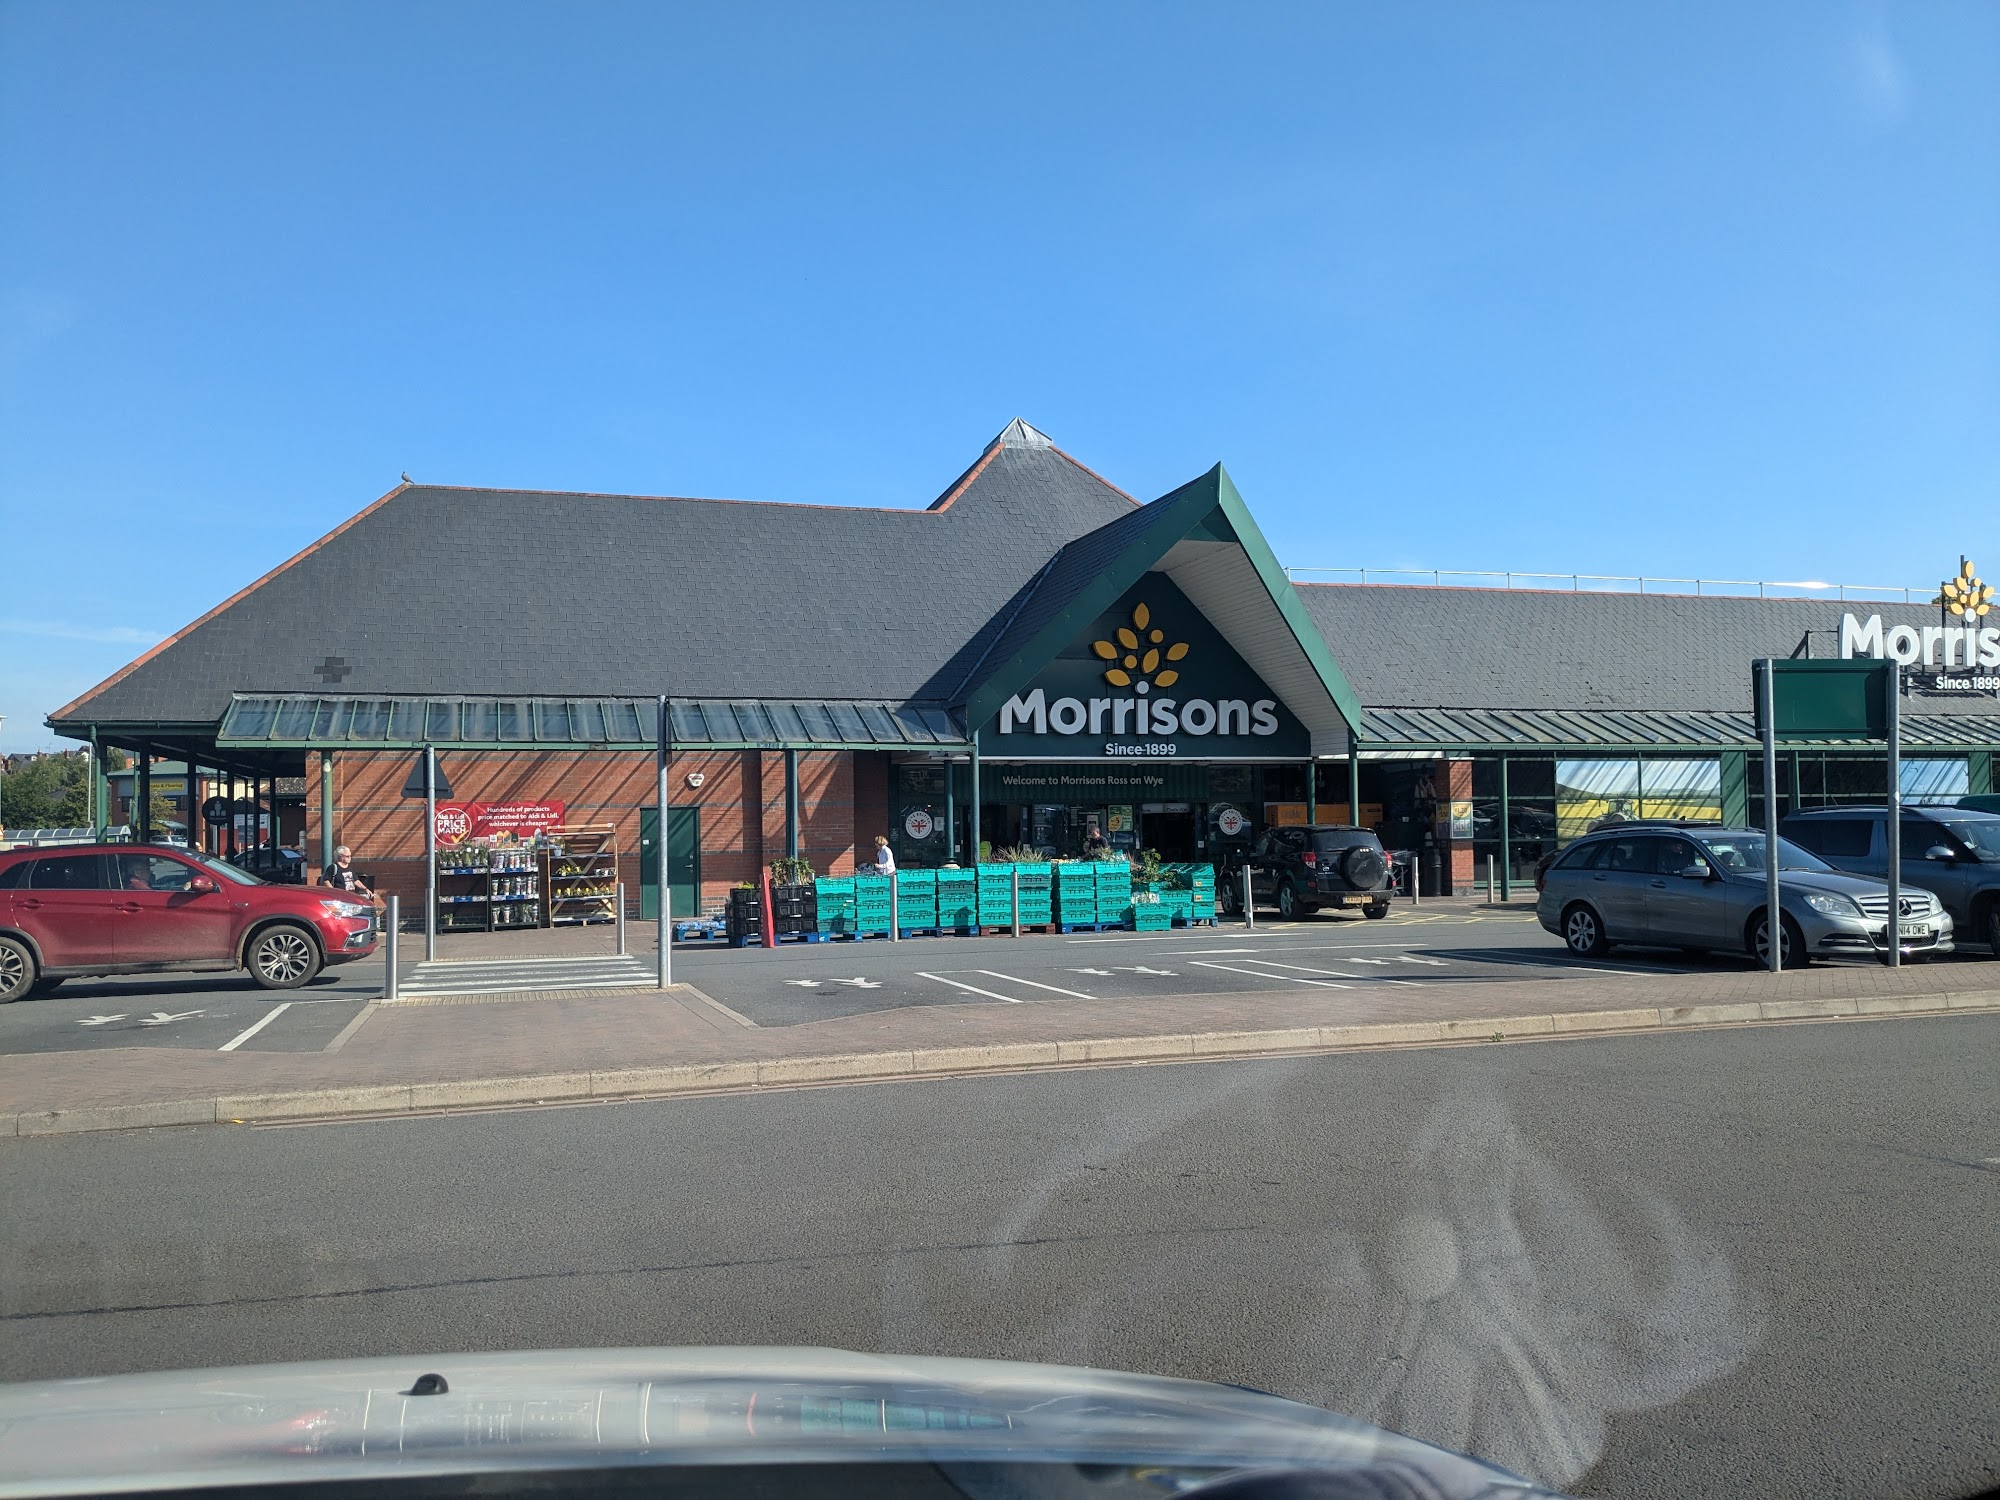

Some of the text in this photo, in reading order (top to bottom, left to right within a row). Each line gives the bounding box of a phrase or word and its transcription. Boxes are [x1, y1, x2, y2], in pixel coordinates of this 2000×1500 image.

[1936, 676, 2000, 690] Since 1899
[1000, 680, 1279, 736] Morrisons
[1105, 743, 1177, 756] Since 1899
[1002, 775, 1164, 788] Welcome to Morrisons Ross on Wye
[437, 820, 466, 828] PRICE
